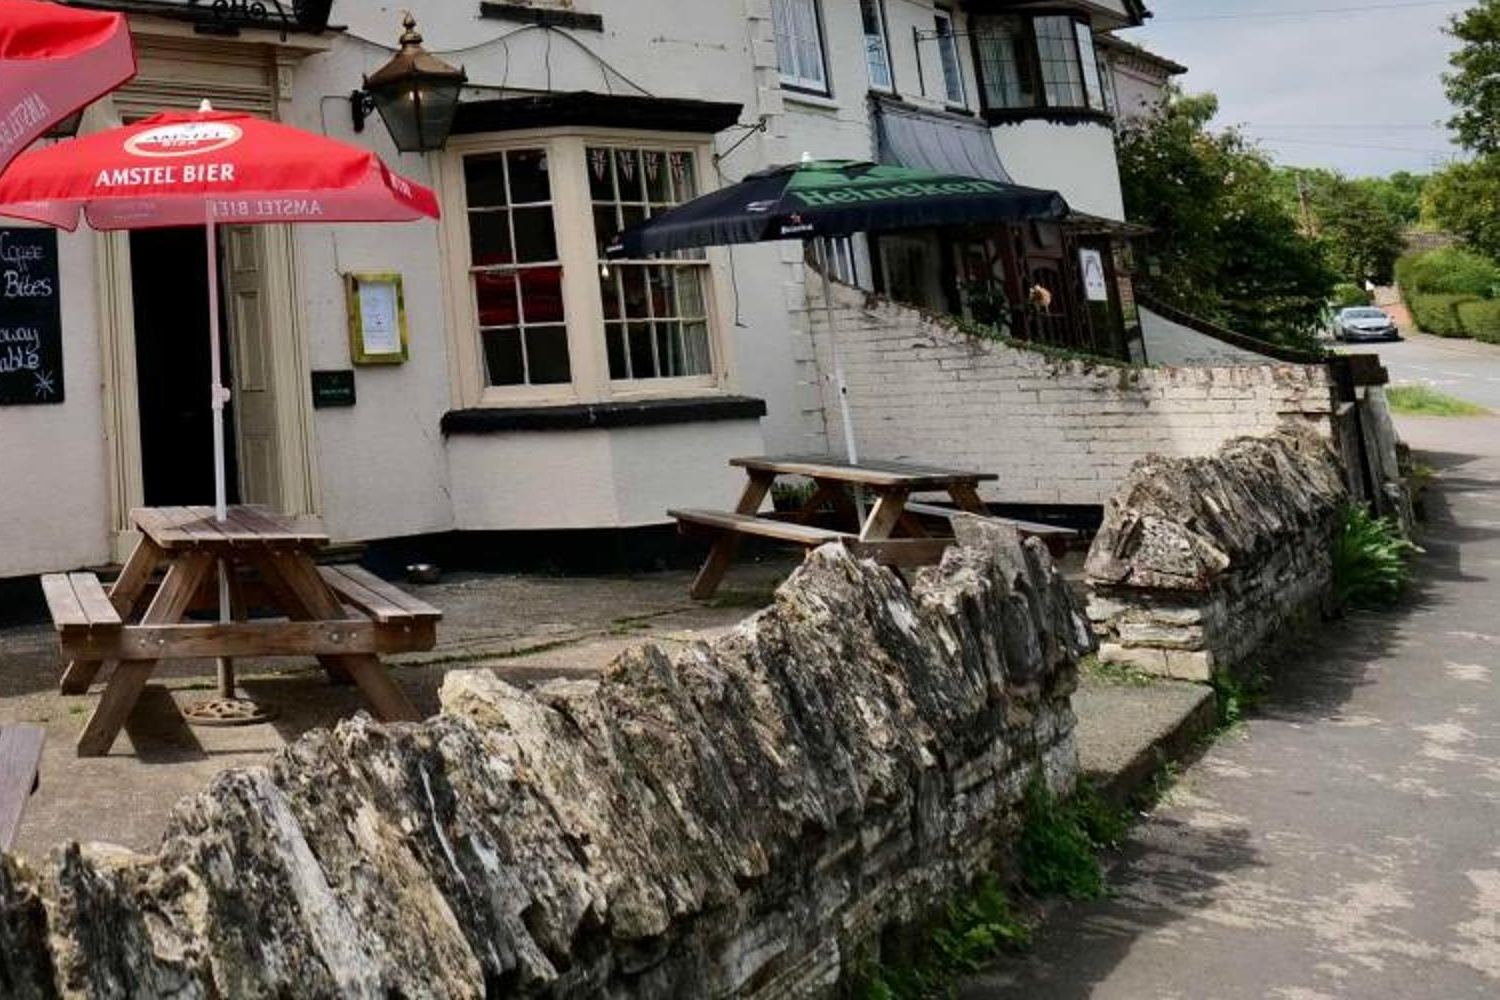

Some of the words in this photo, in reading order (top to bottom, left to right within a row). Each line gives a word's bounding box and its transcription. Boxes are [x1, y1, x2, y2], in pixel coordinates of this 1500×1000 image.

[95, 165, 176, 187] AMSTEL
[183, 163, 235, 182] BIER
[794, 180, 1003, 207] Heineken
[3, 269, 53, 298] Bites
